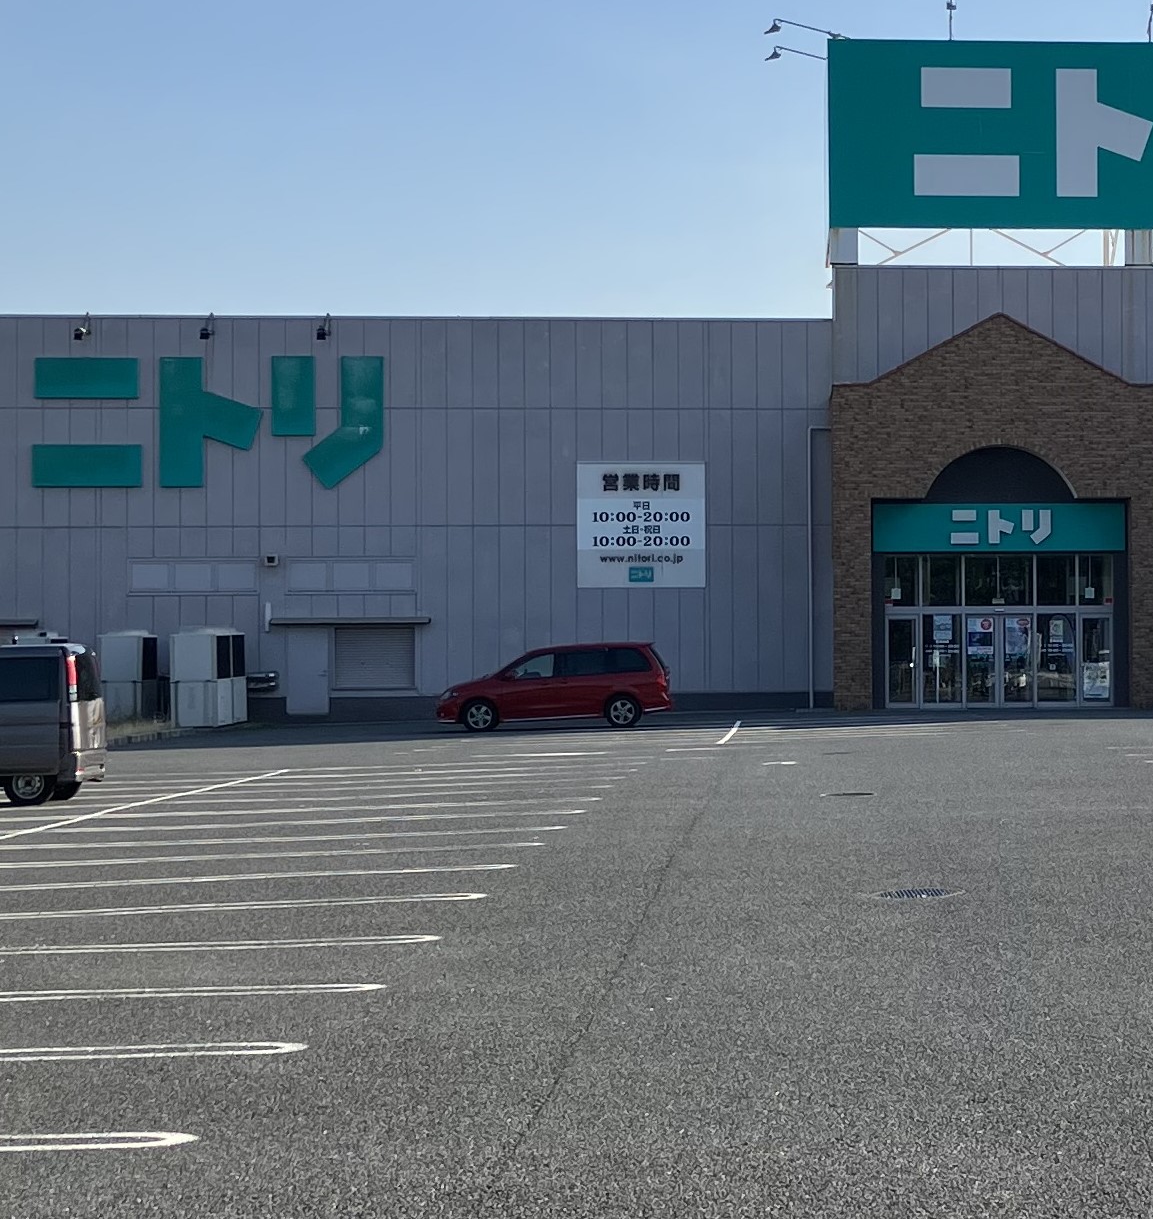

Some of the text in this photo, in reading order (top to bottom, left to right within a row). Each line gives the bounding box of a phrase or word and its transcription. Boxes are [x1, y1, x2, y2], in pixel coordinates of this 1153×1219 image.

[31, 355, 385, 489] ニトリ
[602, 473, 681, 492] 営業時間
[633, 501, 651, 511] 平日
[592, 511, 691, 523] 10:00-20:00
[950, 509, 1052, 545] ニトリ
[592, 535, 691, 547] 10:00-20:00
[600, 553, 684, 564] www.nitori.co.jp
